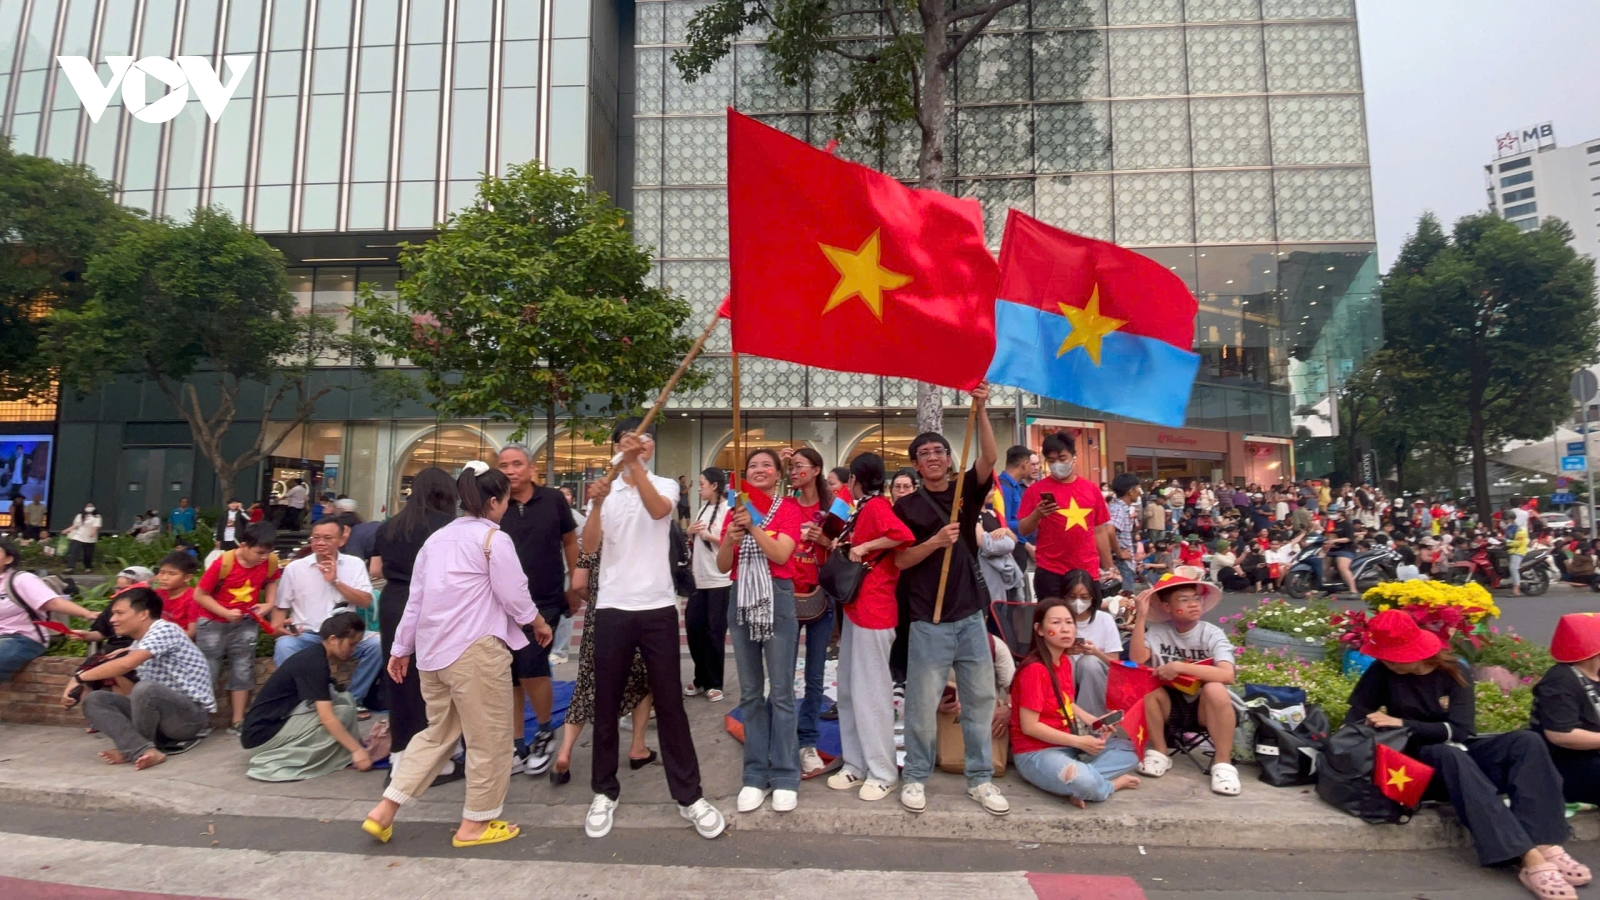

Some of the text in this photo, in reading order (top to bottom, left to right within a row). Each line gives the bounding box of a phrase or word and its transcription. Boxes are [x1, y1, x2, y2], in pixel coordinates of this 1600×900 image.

[1523, 124, 1553, 143] MB
[1363, 453, 1371, 478] SAIGON
[1160, 643, 1210, 660] MALIB
